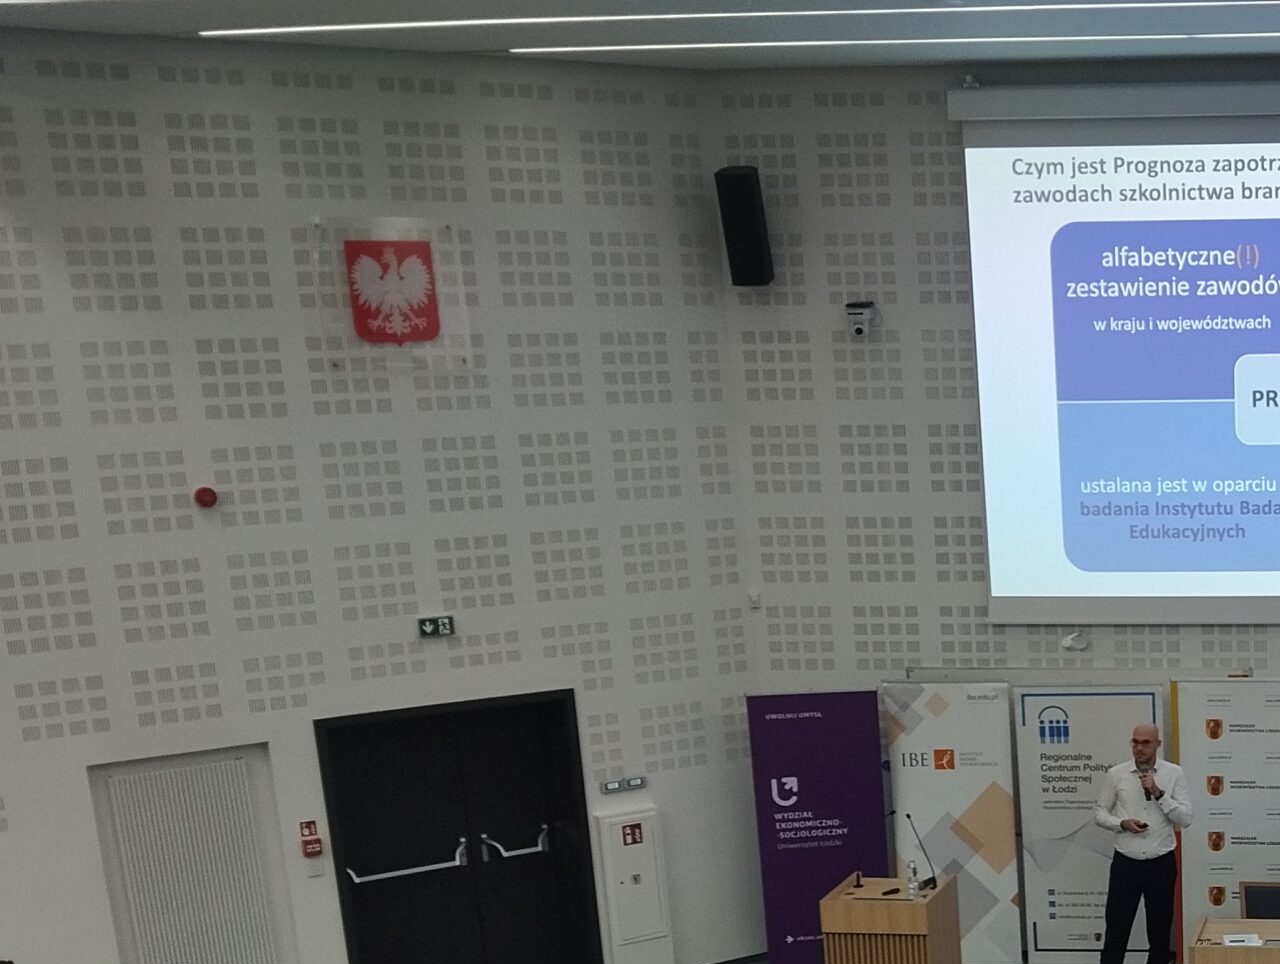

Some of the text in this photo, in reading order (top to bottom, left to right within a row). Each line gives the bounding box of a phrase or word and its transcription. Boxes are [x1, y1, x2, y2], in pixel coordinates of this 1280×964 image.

[1011, 156, 1065, 179] Czym
[1070, 155, 1107, 179] jest
[1113, 154, 1205, 178] Prognoza
[1012, 183, 1113, 203] zawodach
[1119, 181, 1235, 202] szkolnictwa
[1101, 243, 1260, 270] alfabetyczne(!)
[1066, 275, 1190, 298] zestawienie
[1093, 315, 1271, 334] w kraju i województwach
[1080, 477, 1152, 494] ustalana
[1156, 477, 1188, 496] jest
[1192, 480, 1207, 493] w
[1212, 477, 1277, 496] oparciu
[1080, 501, 1149, 517] badania
[1155, 500, 1234, 519] Instytutu
[1129, 523, 1246, 542] Edukacyjnych
[901, 752, 929, 768] IBE
[1040, 752, 1093, 763] Regionalne
[1040, 763, 1081, 772] Centrum
[1041, 774, 1093, 785] Społecznej
[1052, 785, 1078, 793] Łodzi
[773, 811, 814, 820] WYDZIAŁ
[775, 819, 843, 830] EKONOMICZNO-
[776, 828, 849, 839] -SOCJOLOGICZNY
